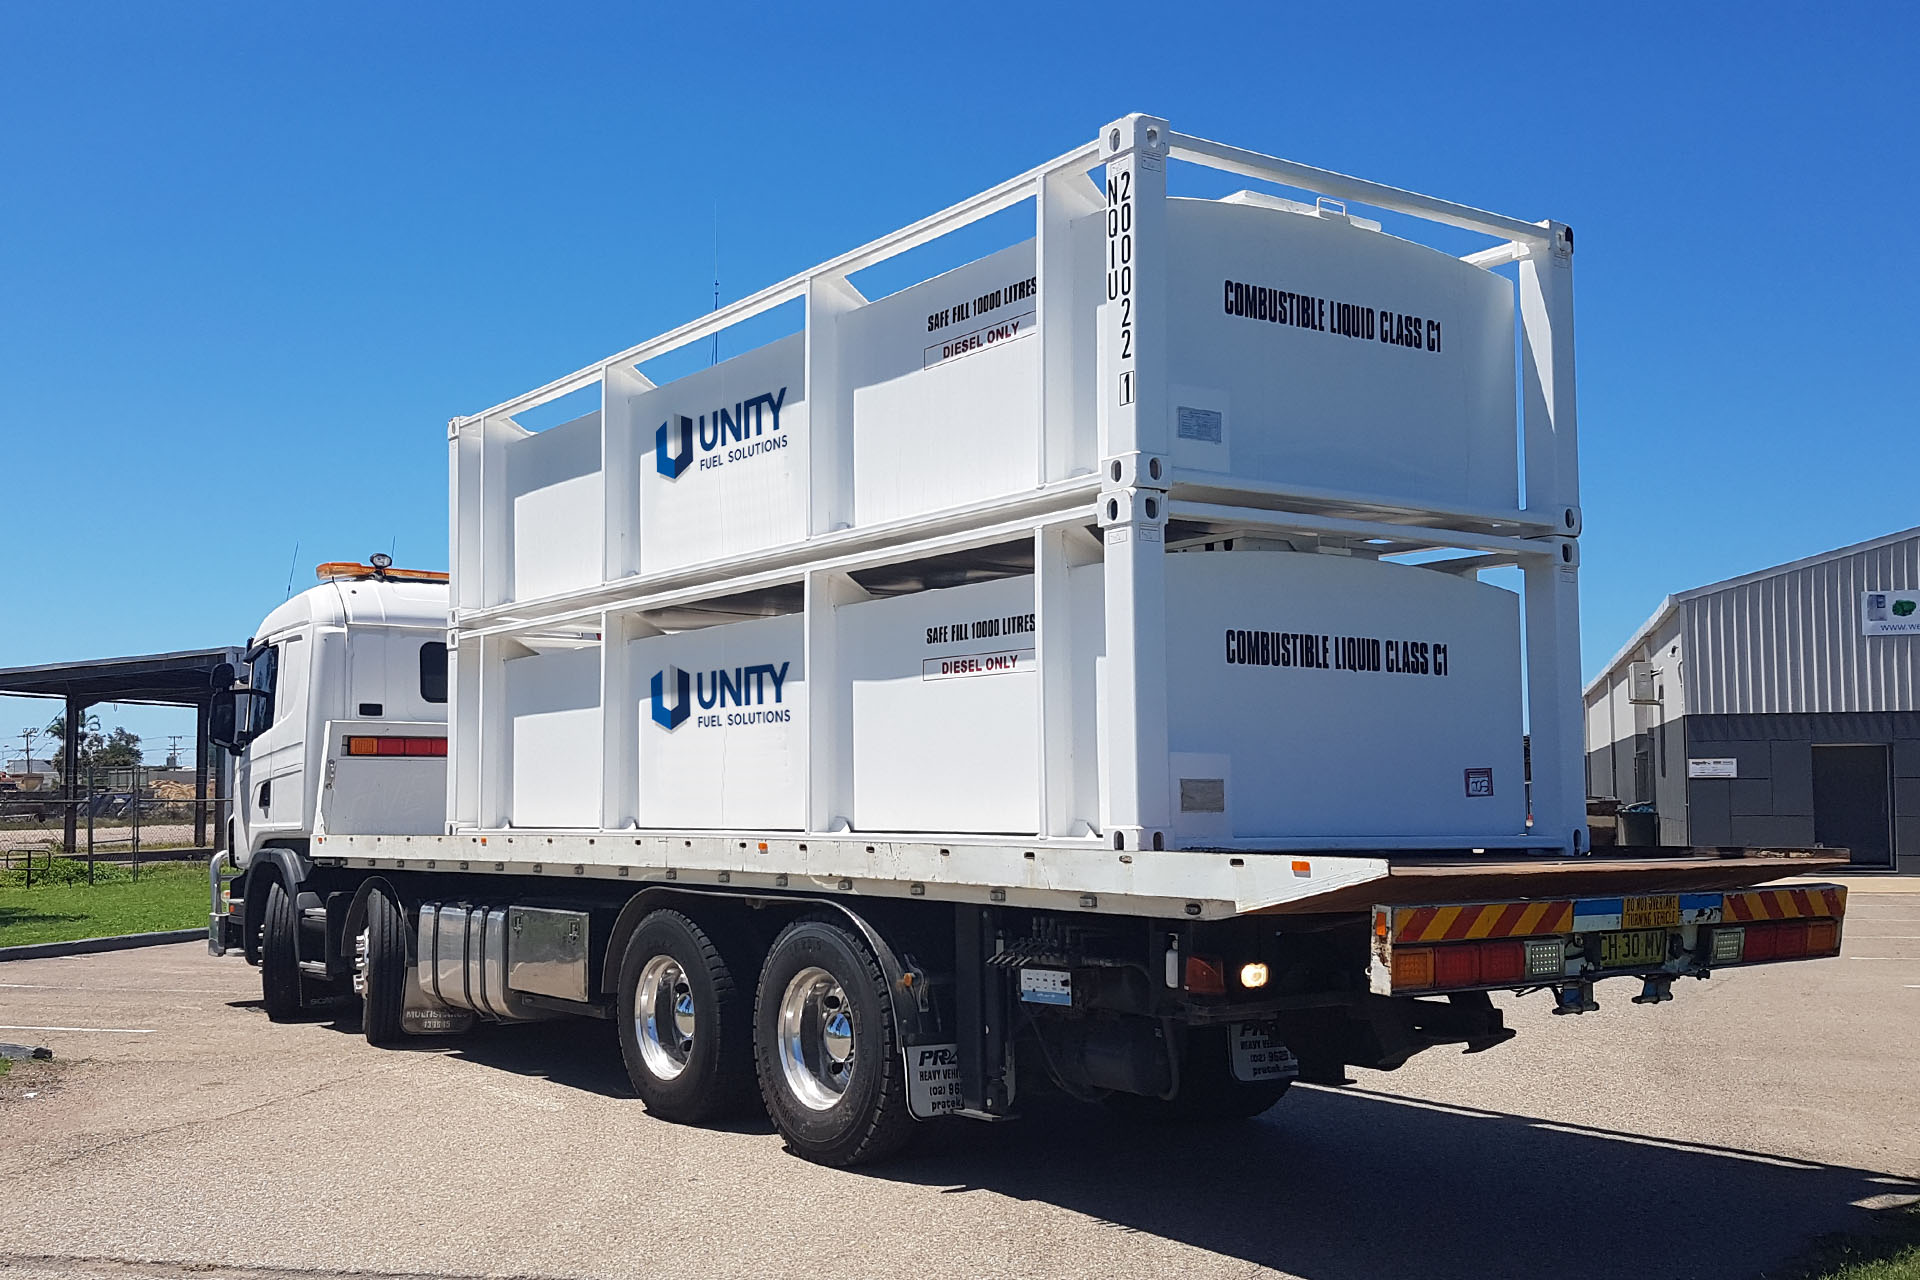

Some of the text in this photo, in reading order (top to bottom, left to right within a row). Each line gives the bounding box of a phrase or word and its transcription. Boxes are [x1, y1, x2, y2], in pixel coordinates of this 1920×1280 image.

[928, 276, 1036, 332] SAFE FILL 10000 LITRES
[1224, 279, 1441, 352] COMBUSTIBLE LIQUID CLASS C1
[943, 321, 1020, 359] DIESEL ONLY
[699, 386, 787, 452] UNITY
[700, 434, 788, 471] FUEL SOLUTIONS
[926, 614, 1036, 645] SAFE FILL 10000 LITRES
[942, 655, 1018, 675] DIESEL ONLY
[1225, 629, 1448, 676] COMBUSTIBLE LIQUID CLASS C1
[697, 661, 790, 710] UNITY
[697, 709, 791, 728] FUEL SOLUTIONS
[1626, 911, 1652, 927] TURNING
[930, 1086, 946, 1097] (02)
